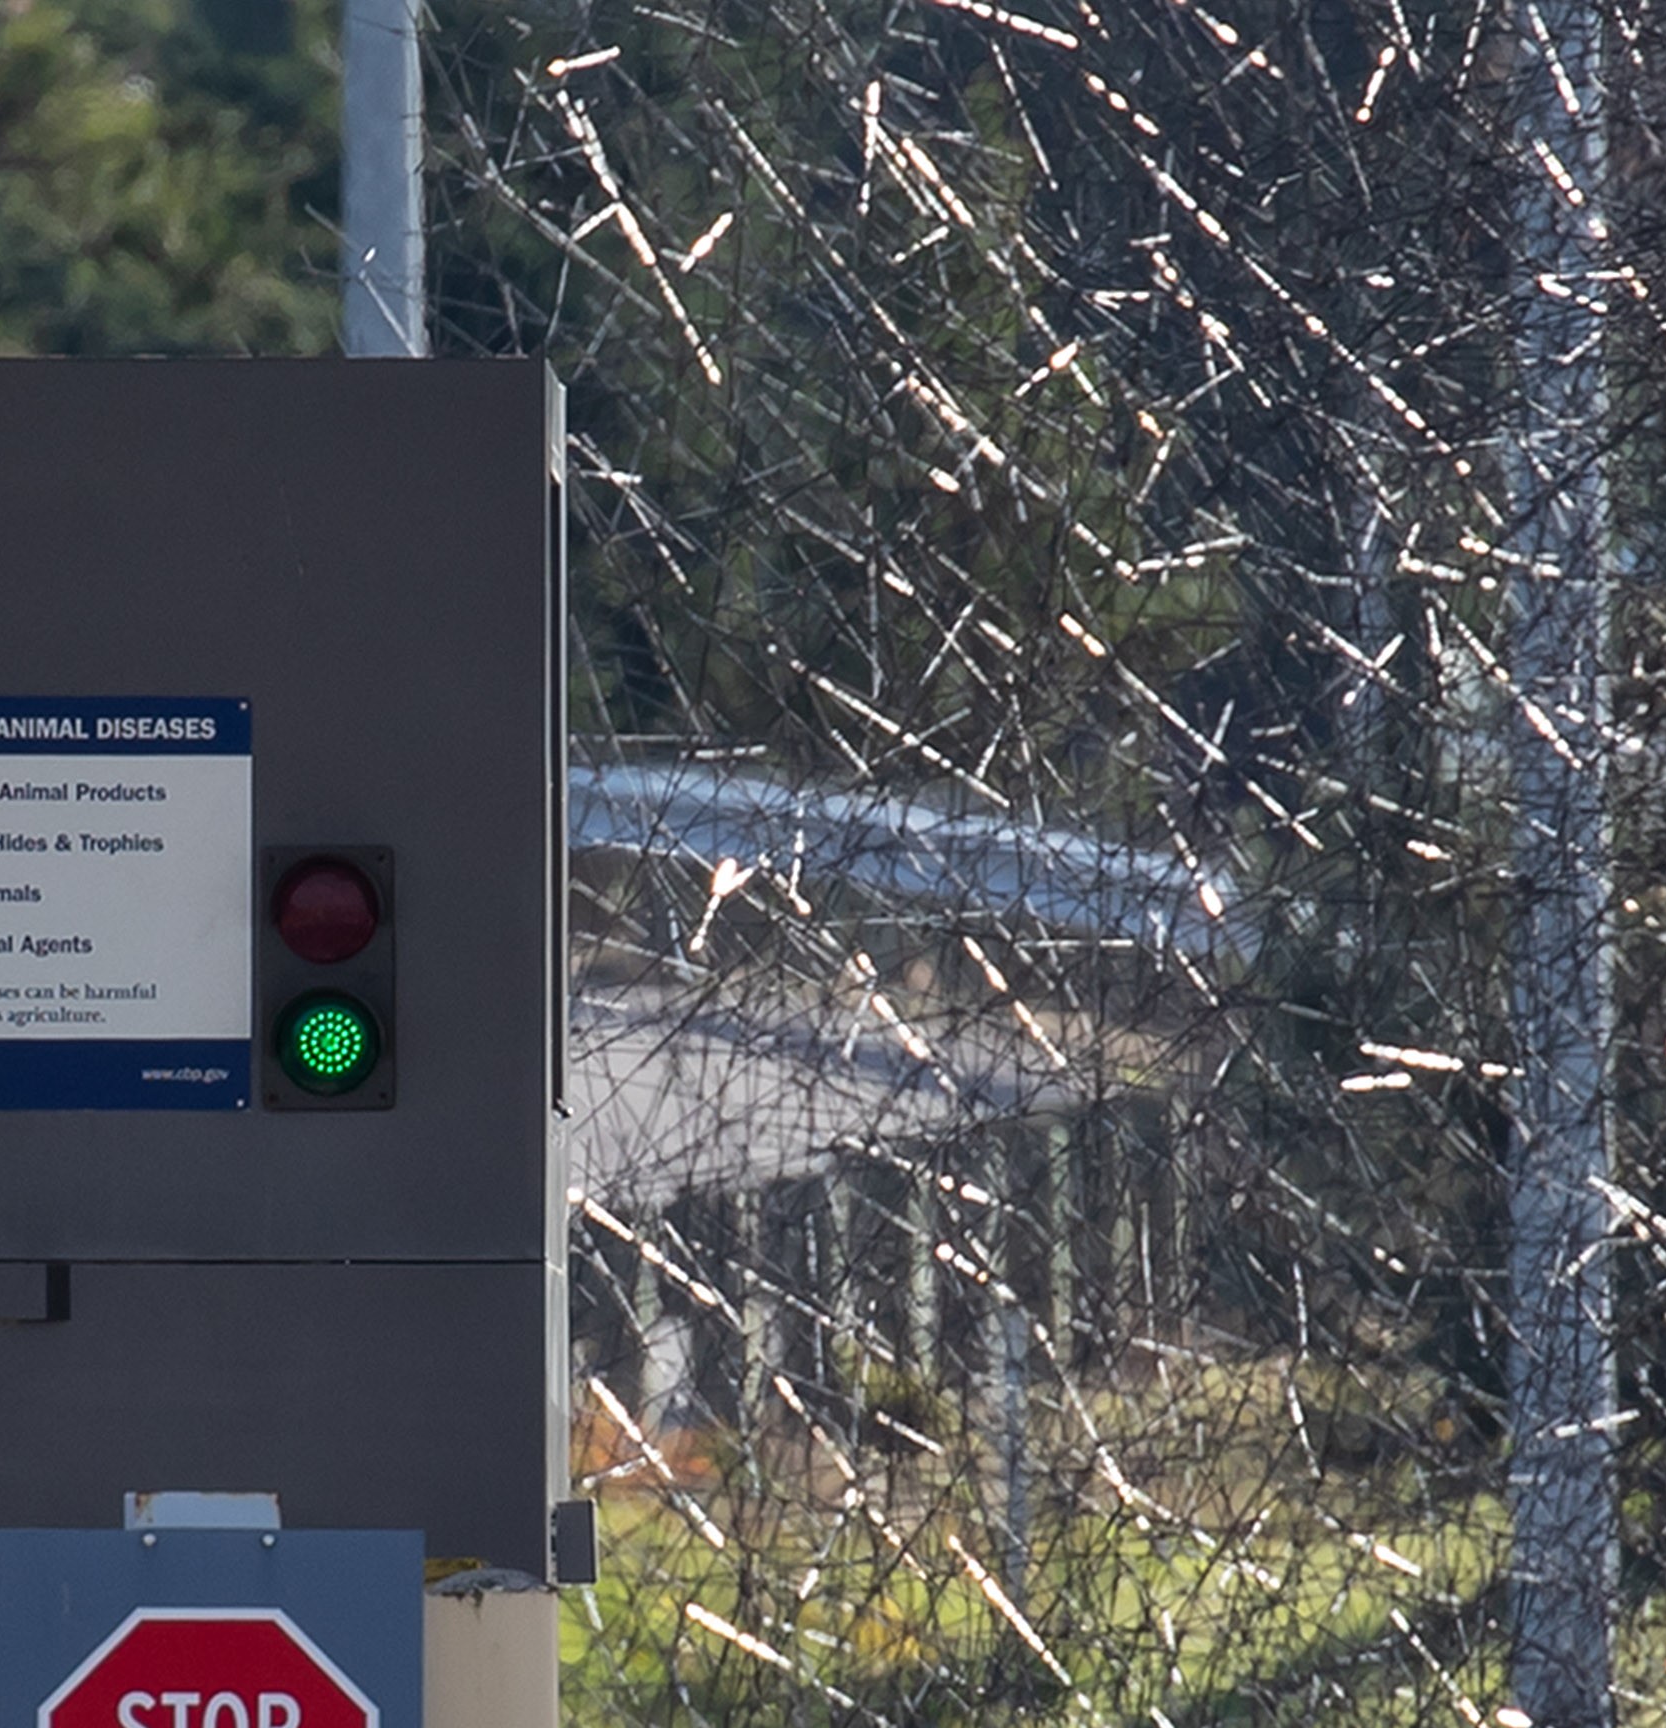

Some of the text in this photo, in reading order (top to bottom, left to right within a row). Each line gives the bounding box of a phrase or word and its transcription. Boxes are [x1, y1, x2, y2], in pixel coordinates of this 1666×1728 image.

[97, 717, 216, 740] DISEASES
[76, 783, 167, 802] Products
[54, 833, 72, 852] &
[79, 833, 165, 856] Trophies
[20, 934, 93, 957] Agents
[25, 987, 55, 1000] can
[59, 983, 80, 1000] be
[84, 983, 157, 1000] harmful
[7, 1006, 106, 1028] agriculture.
